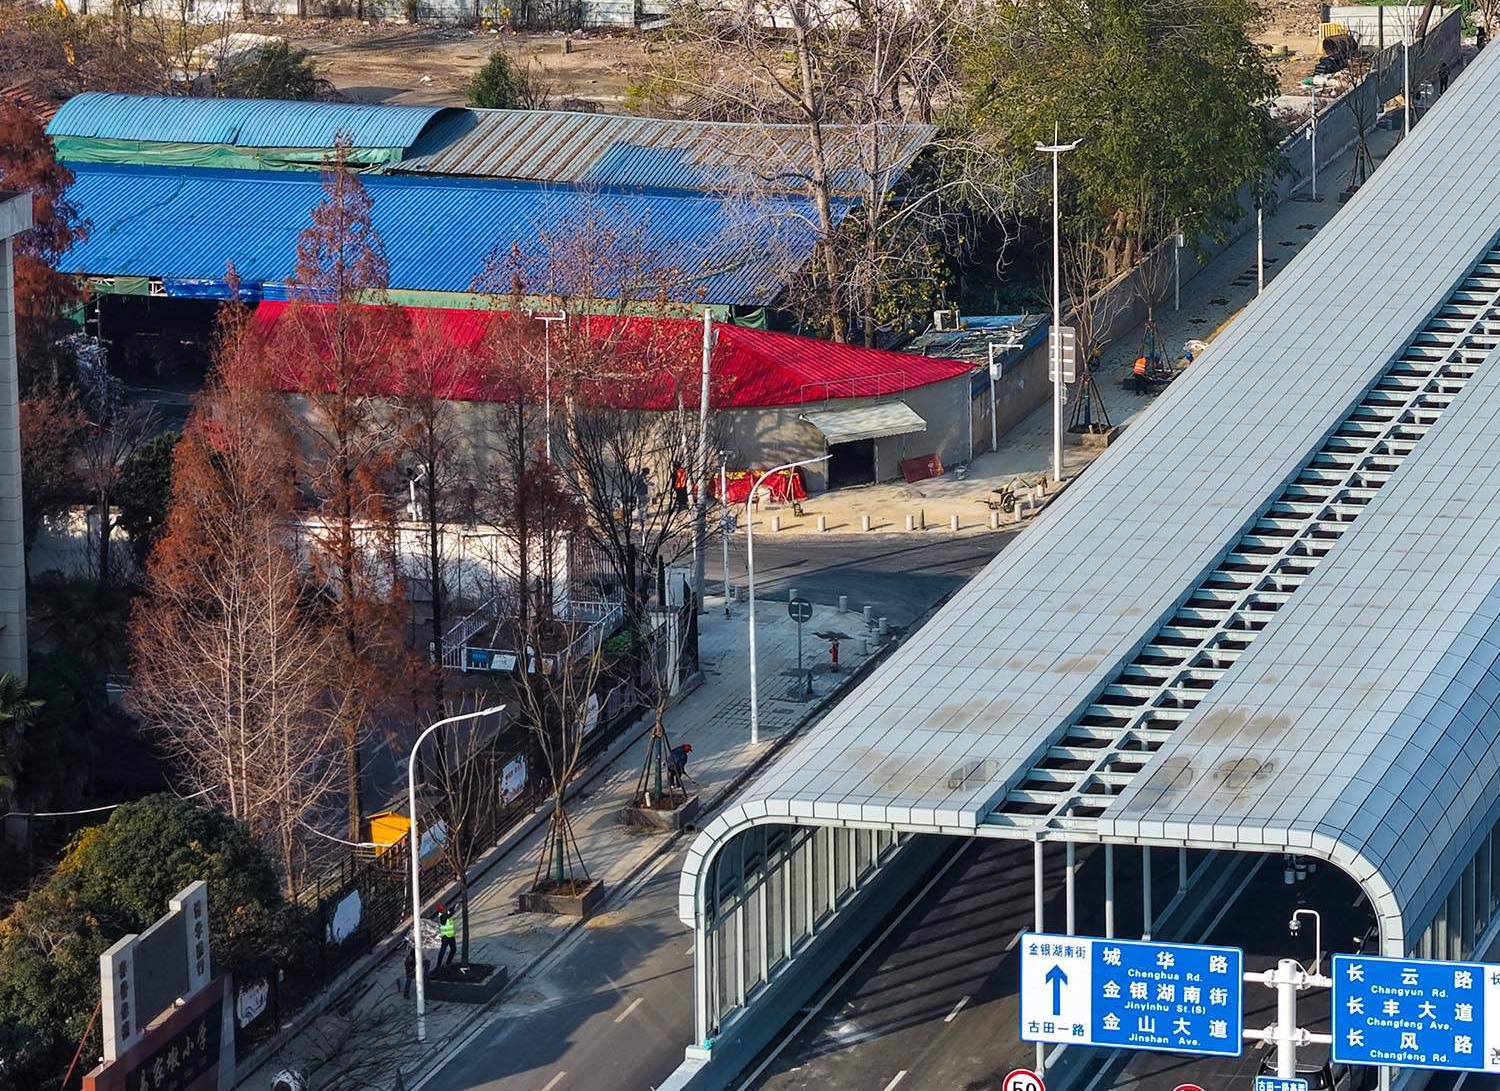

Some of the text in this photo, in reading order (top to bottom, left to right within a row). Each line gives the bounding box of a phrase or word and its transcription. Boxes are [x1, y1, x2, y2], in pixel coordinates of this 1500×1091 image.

[1028, 943, 1086, 959] 金银湖南街
[1103, 947, 1228, 974] 城华路
[1128, 968, 1203, 982] Chenghua Rd.
[1346, 963, 1473, 990] 长云路
[1103, 980, 1228, 1006] 金银湖南街
[1370, 985, 1449, 998] Changyun Rd.
[1124, 1001, 1206, 1015] Jinyinhu St.(S)
[1346, 996, 1473, 1022] 长丰大道
[1028, 1020, 1086, 1038] 古田一路
[1103, 1012, 1228, 1039] 金山大道
[1366, 1017, 1453, 1031] Changfeng Ave.
[1128, 1033, 1201, 1047] Jinshan Ave.
[1346, 1028, 1473, 1054] 长风路
[1369, 1049, 1450, 1063] Changfeng Rd.
